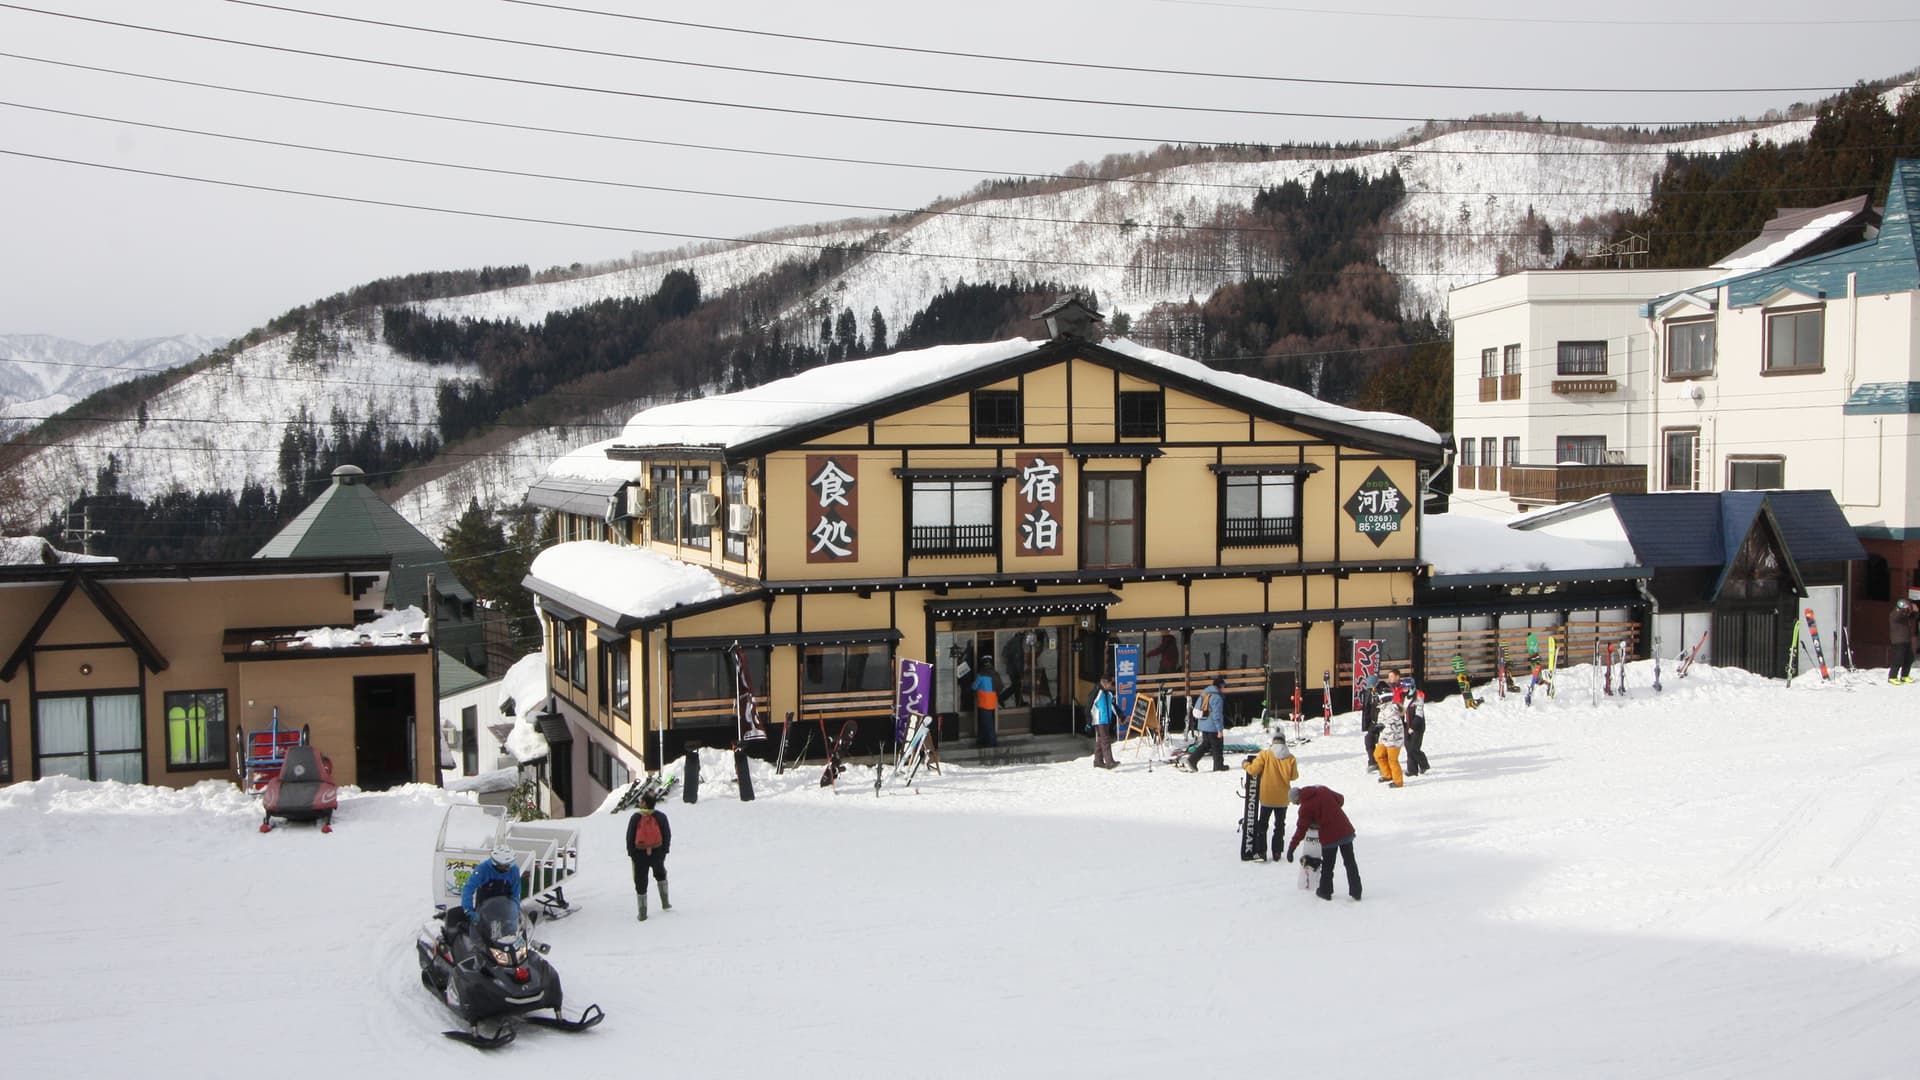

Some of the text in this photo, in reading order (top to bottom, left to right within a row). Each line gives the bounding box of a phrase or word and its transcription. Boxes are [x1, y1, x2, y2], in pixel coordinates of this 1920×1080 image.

[810, 460, 856, 558] 食処
[1019, 458, 1060, 551] 宿泊
[1358, 487, 1399, 513] 河廣
[1364, 514, 1393, 522] (0269)
[1118, 659, 1135, 712] 生ビー
[1245, 775, 1258, 854] PRINGBREAK
